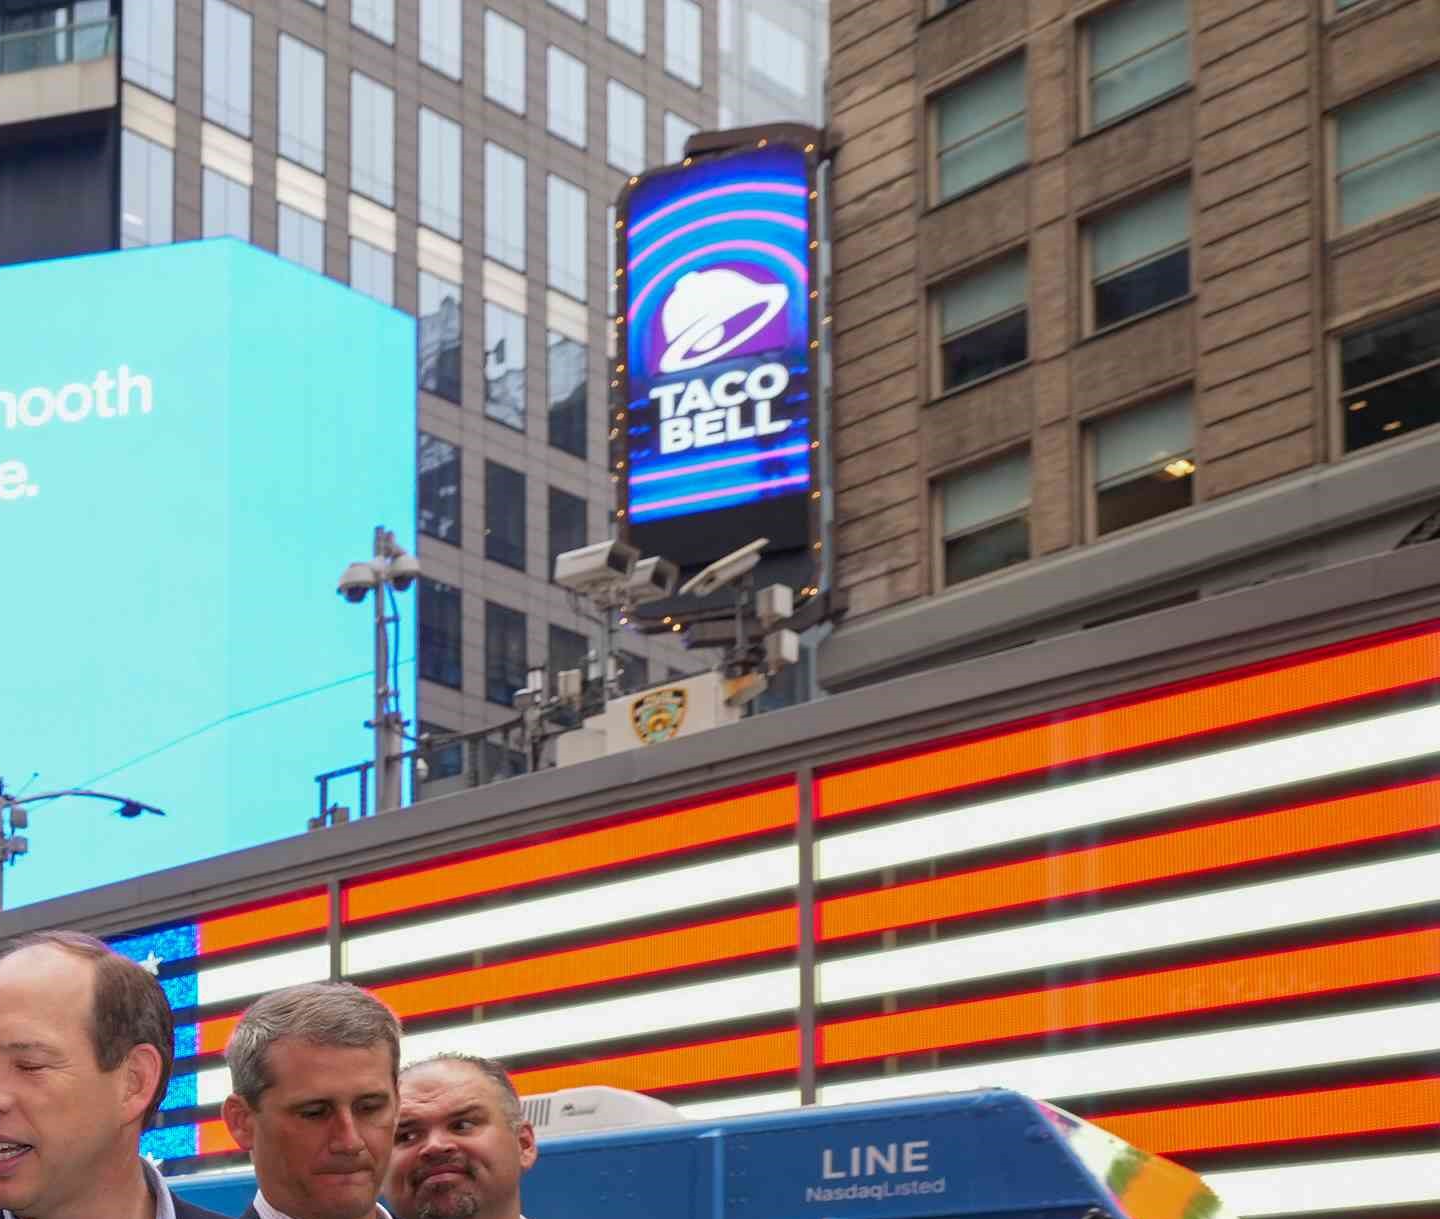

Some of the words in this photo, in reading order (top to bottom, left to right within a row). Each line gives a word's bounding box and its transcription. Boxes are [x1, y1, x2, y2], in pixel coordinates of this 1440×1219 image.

[649, 363, 789, 420] TACO
[660, 400, 792, 454] BELL
[823, 1140, 929, 1179] LINE
[805, 1176, 946, 1202] NasdaqListed
